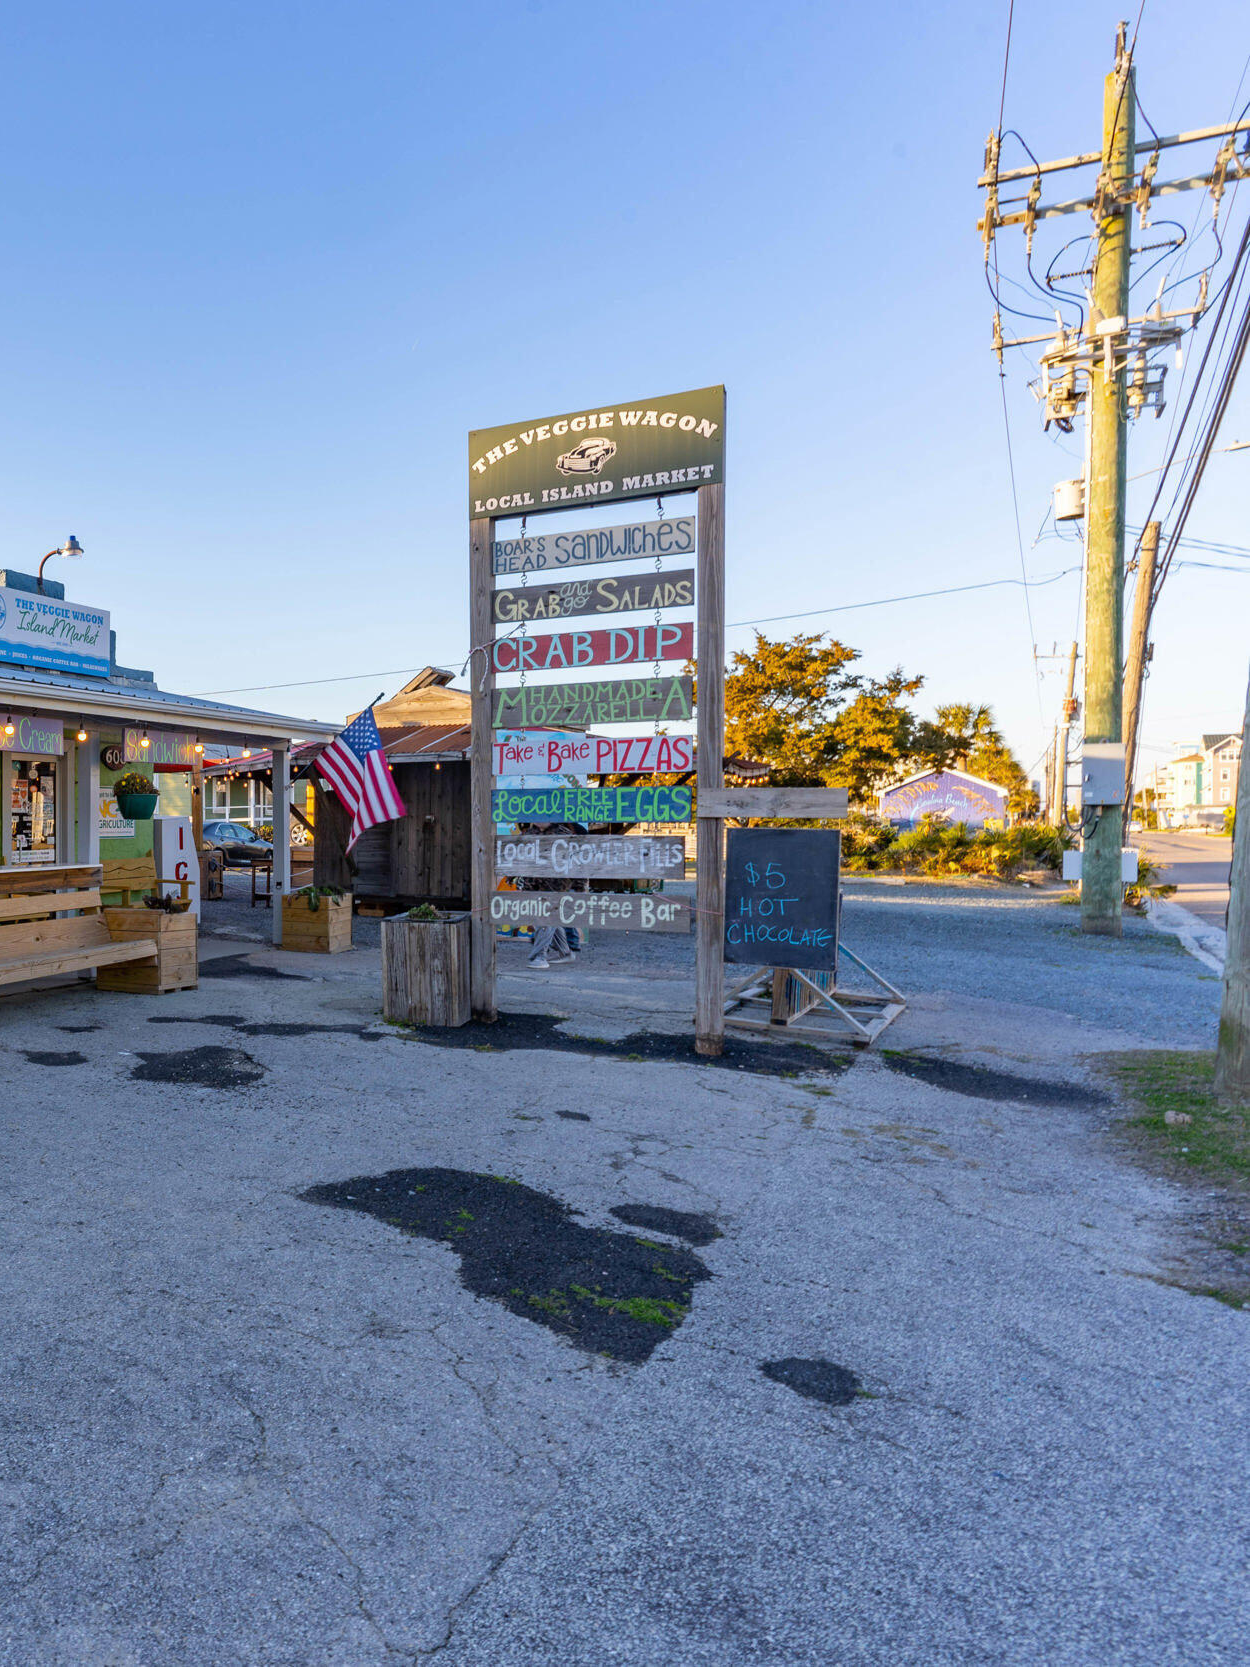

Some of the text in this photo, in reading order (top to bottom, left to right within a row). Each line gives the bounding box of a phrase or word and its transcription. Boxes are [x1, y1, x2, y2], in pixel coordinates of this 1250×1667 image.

[472, 410, 718, 475] THE VEGGIE WAGON
[474, 464, 715, 513] LOCAL ISLAND MARKET
[494, 536, 546, 558] BOAR'S
[494, 554, 547, 574] HEAD
[14, 598, 35, 611] THE
[36, 601, 70, 619] VEGGIE
[71, 610, 104, 626] WAGON
[494, 578, 692, 622] GRAB and go SALADS
[16, 610, 100, 646] Island Market
[493, 624, 683, 672] CRAB DIP
[493, 677, 691, 728] MOZZARELLA
[529, 679, 663, 705] HANDMADE
[19, 717, 63, 755] Cream
[126, 729, 196, 763] Sandwich
[493, 743, 534, 774] Take
[547, 741, 590, 772] Bake
[596, 737, 690, 772] PIZZAS
[492, 786, 691, 822] Local FREE RANGE EGGS
[99, 819, 134, 829] GRICULTURE
[744, 862, 786, 889] $5
[490, 895, 682, 928] Organic Coffee Bar
[739, 896, 799, 917] HOT
[726, 923, 833, 948] CHOCOLATE
